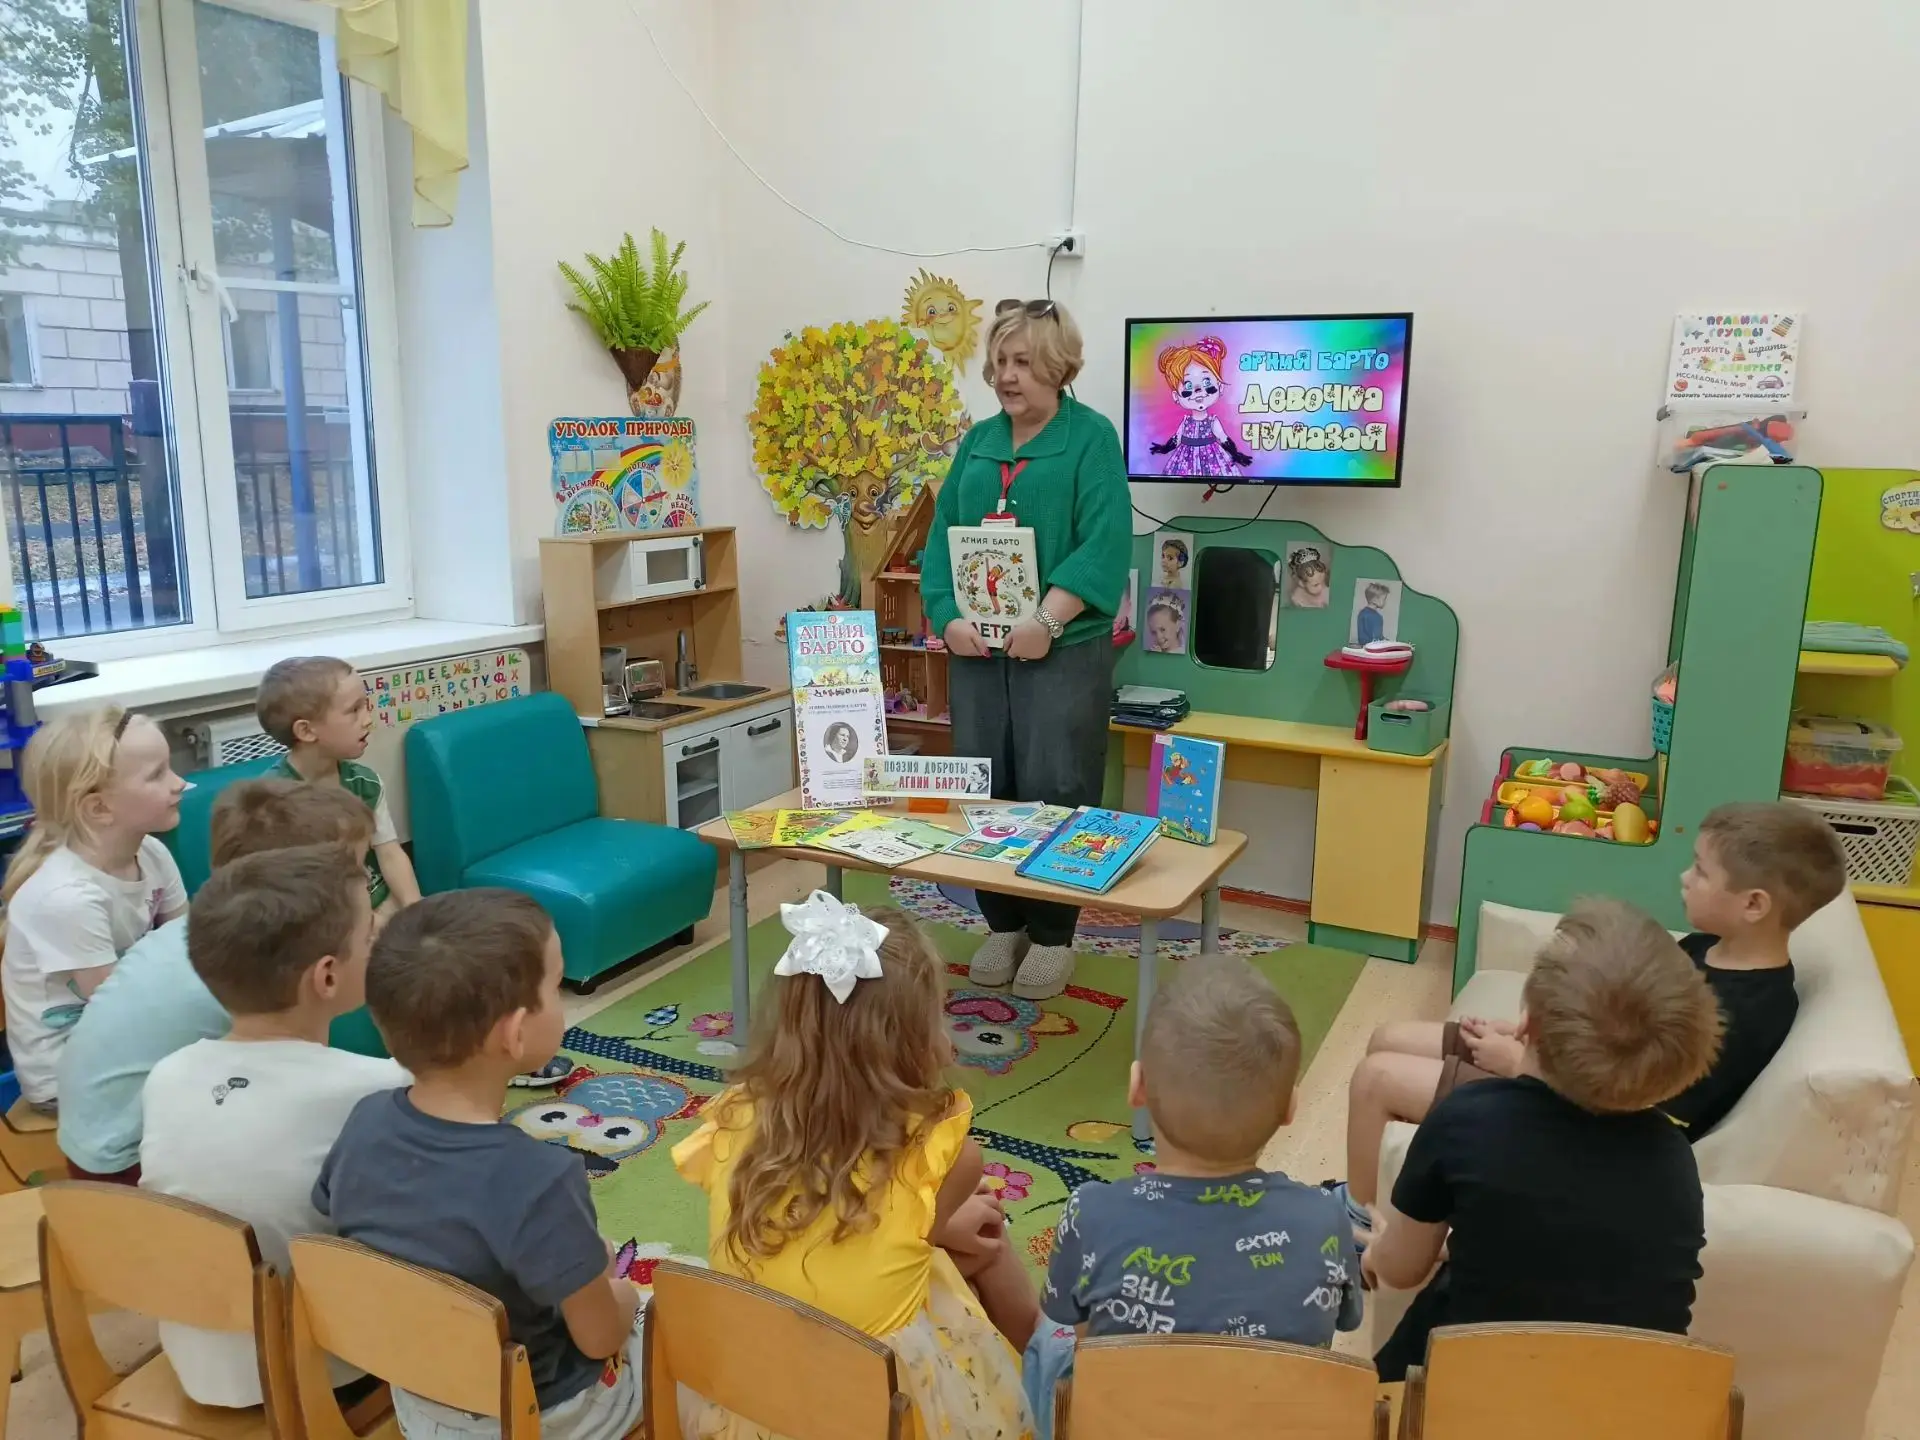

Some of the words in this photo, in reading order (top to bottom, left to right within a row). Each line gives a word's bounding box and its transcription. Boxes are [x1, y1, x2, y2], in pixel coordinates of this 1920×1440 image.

[1682, 345, 1731, 356] ДРУЖИТЬ
[554, 421, 620, 437] УГОЛОК
[625, 421, 693, 437] ПРИРОДЫ
[961, 536, 988, 545] АГНИЯ
[992, 538, 1020, 546] БАРТО
[800, 625, 865, 639] АГНИЯ
[800, 640, 865, 655] БАРТО
[884, 760, 919, 773] ПОЭЗИЯ
[924, 762, 968, 775] ДОБРОТЫ
[899, 775, 929, 789] АГНИИ
[935, 776, 967, 790] БАРТО
[1235, 1230, 1291, 1252] EXTRA
[1122, 1247, 1196, 1285] DAY
[1250, 1252, 1285, 1269] FUN
[1121, 1274, 1175, 1306] THE
